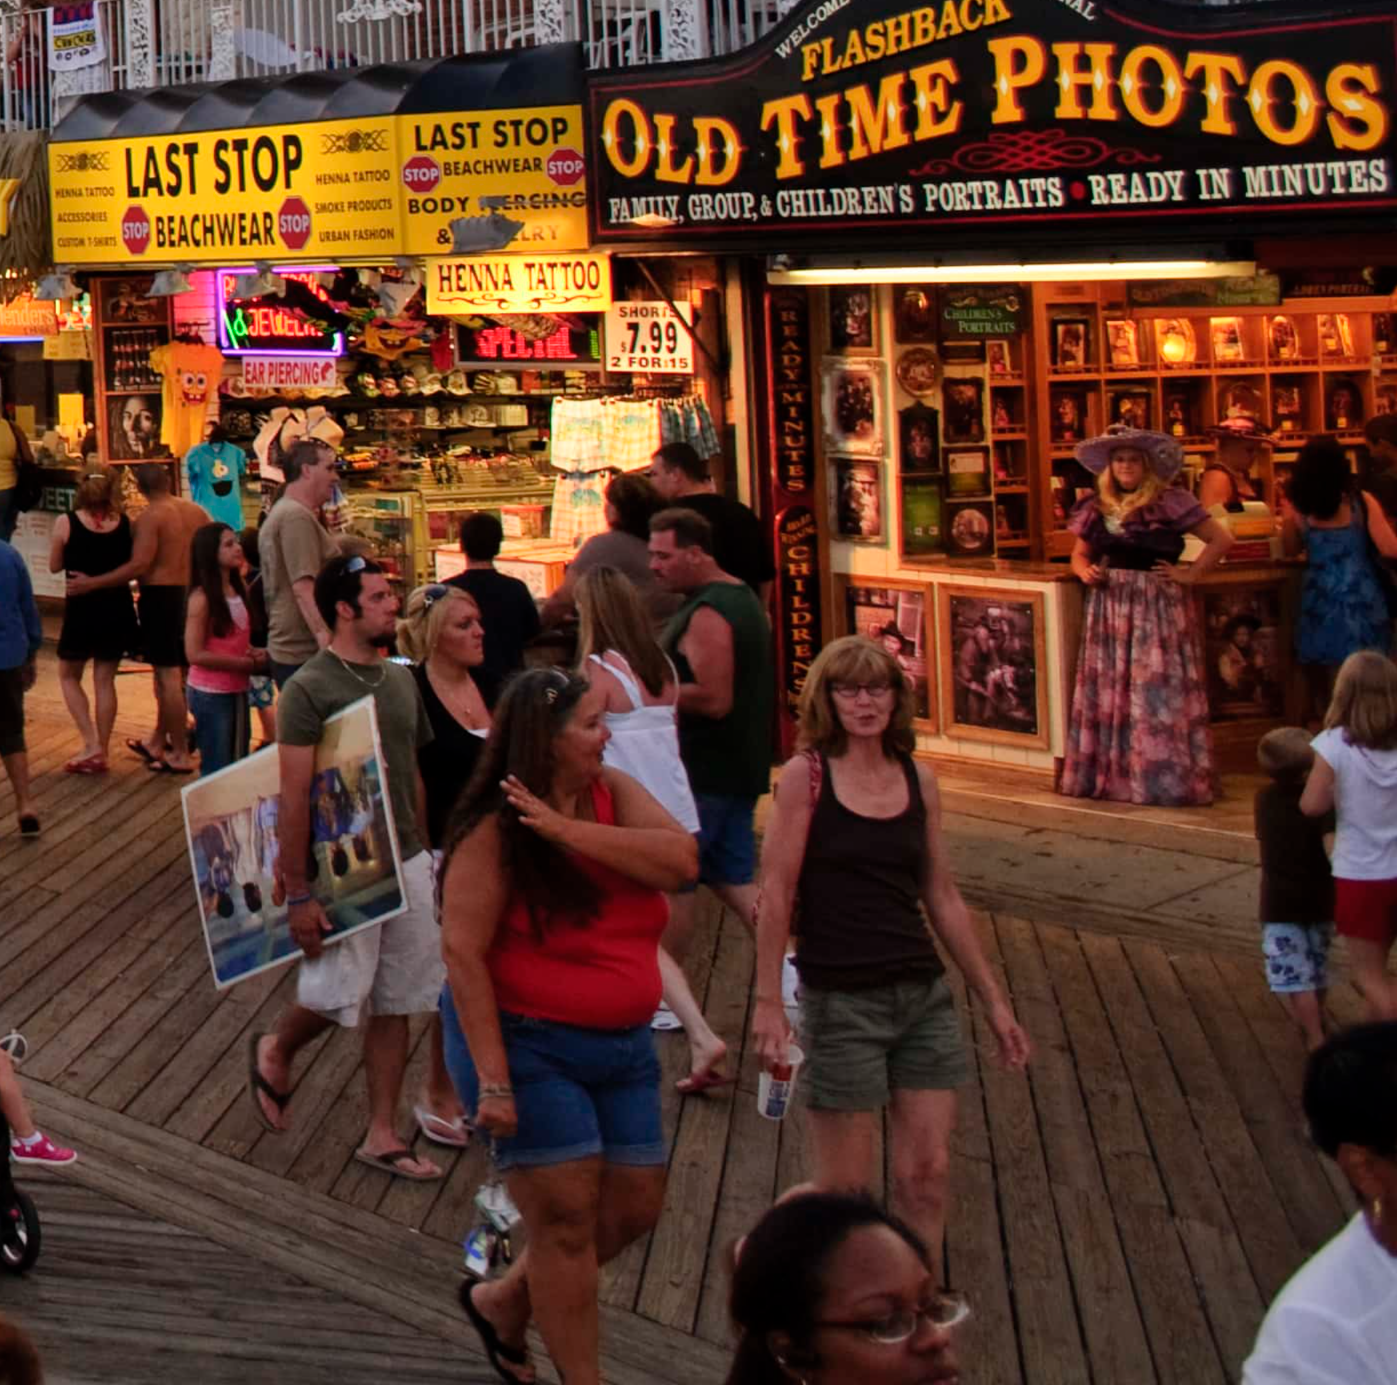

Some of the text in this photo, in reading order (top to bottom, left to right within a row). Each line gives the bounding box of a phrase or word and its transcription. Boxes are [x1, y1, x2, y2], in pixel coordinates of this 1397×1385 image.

[802, 0, 1014, 81] FLASHBACK
[603, 35, 1389, 186] OLD TIME PHOTOS
[414, 117, 569, 151] LAST STOP
[125, 134, 303, 198] LAST STOP
[404, 168, 440, 182] STOP
[443, 157, 543, 176] BEACHWEAR
[548, 160, 584, 174] STOP
[316, 169, 391, 186] HENNA TATTOO
[1089, 158, 1389, 206] READY IN MINUTES
[55, 186, 115, 198] HENNA TATTOO
[609, 176, 1064, 224] FAMILY, GROUP, & CHILDREN'S PORTRAITS
[315, 198, 393, 214] SMOKE PRODUCTS
[408, 192, 586, 214] BODY ERCING
[57, 211, 108, 223] ACCESSORIES
[280, 214, 311, 234] STOP
[123, 222, 150, 239] STOP
[155, 211, 275, 248] BEACHWEAR
[319, 227, 395, 243] URBAN FASHION
[437, 228, 452, 245] &
[57, 237, 85, 248] CUSTOM
[438, 260, 601, 293] HENNA TATTOO
[958, 321, 1016, 334] PORTRAITS
[780, 310, 802, 381] READY
[611, 356, 622, 368] 2
[628, 356, 662, 368] FOR
[245, 361, 320, 385] EAR PIERCING
[781, 392, 806, 492] MINUTES
